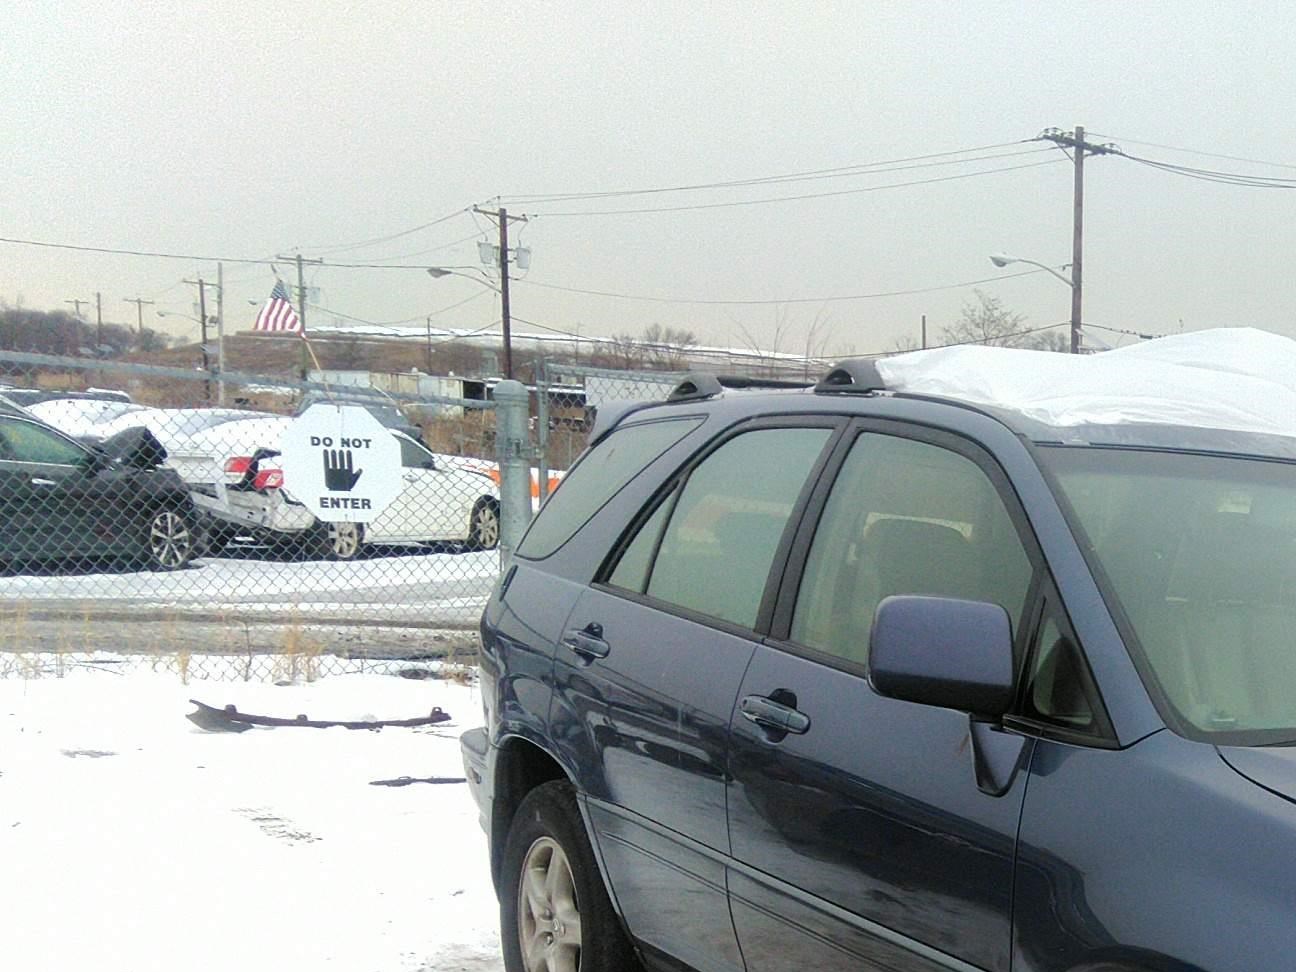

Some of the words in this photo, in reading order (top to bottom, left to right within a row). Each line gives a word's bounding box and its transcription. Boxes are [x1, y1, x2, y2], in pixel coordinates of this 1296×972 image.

[310, 436, 333, 447] DO
[340, 438, 371, 449] NOT
[319, 497, 371, 509] ENTER
